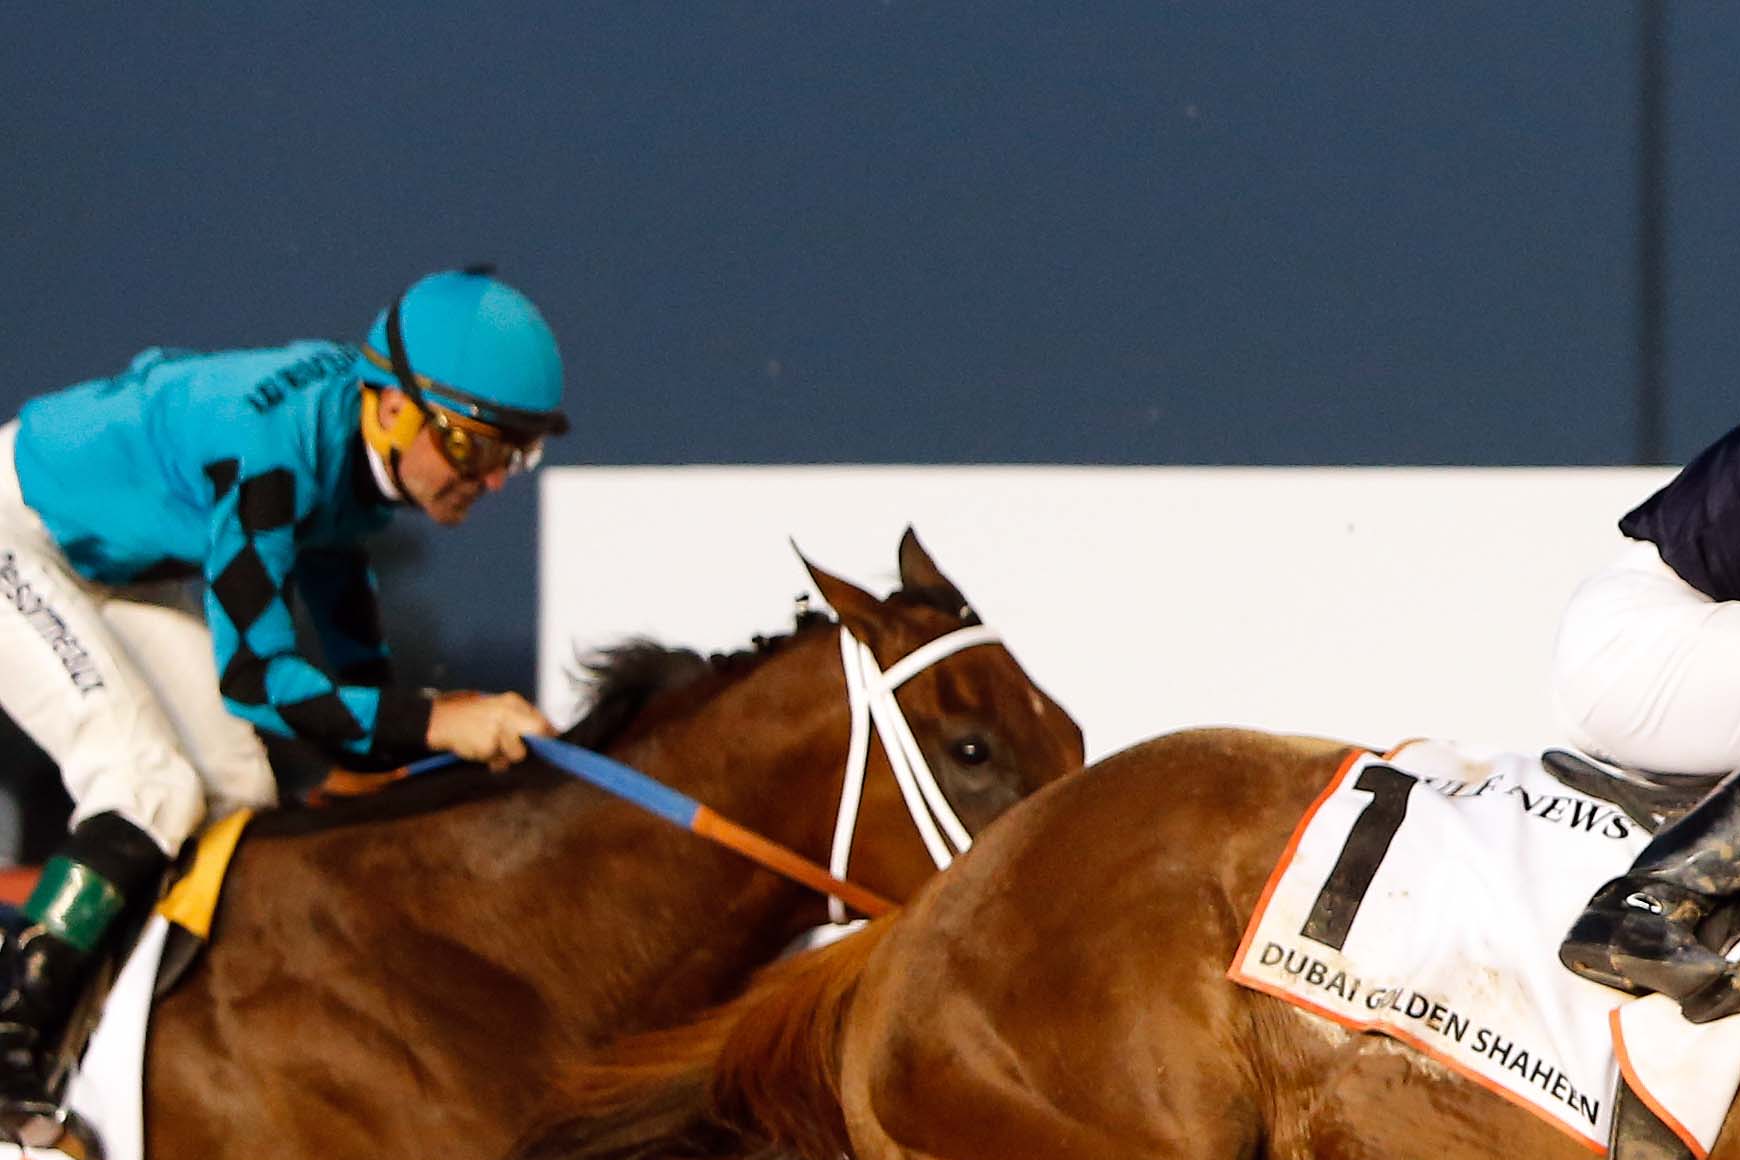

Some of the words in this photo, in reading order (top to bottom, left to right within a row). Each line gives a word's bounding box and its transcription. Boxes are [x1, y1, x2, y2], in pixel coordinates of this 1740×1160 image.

[1301, 764, 1418, 951] 1
[1504, 785, 1632, 840] NEWS
[1259, 942, 1361, 1002] DUBAI
[1472, 1029, 1600, 1126] SHAHEEN
